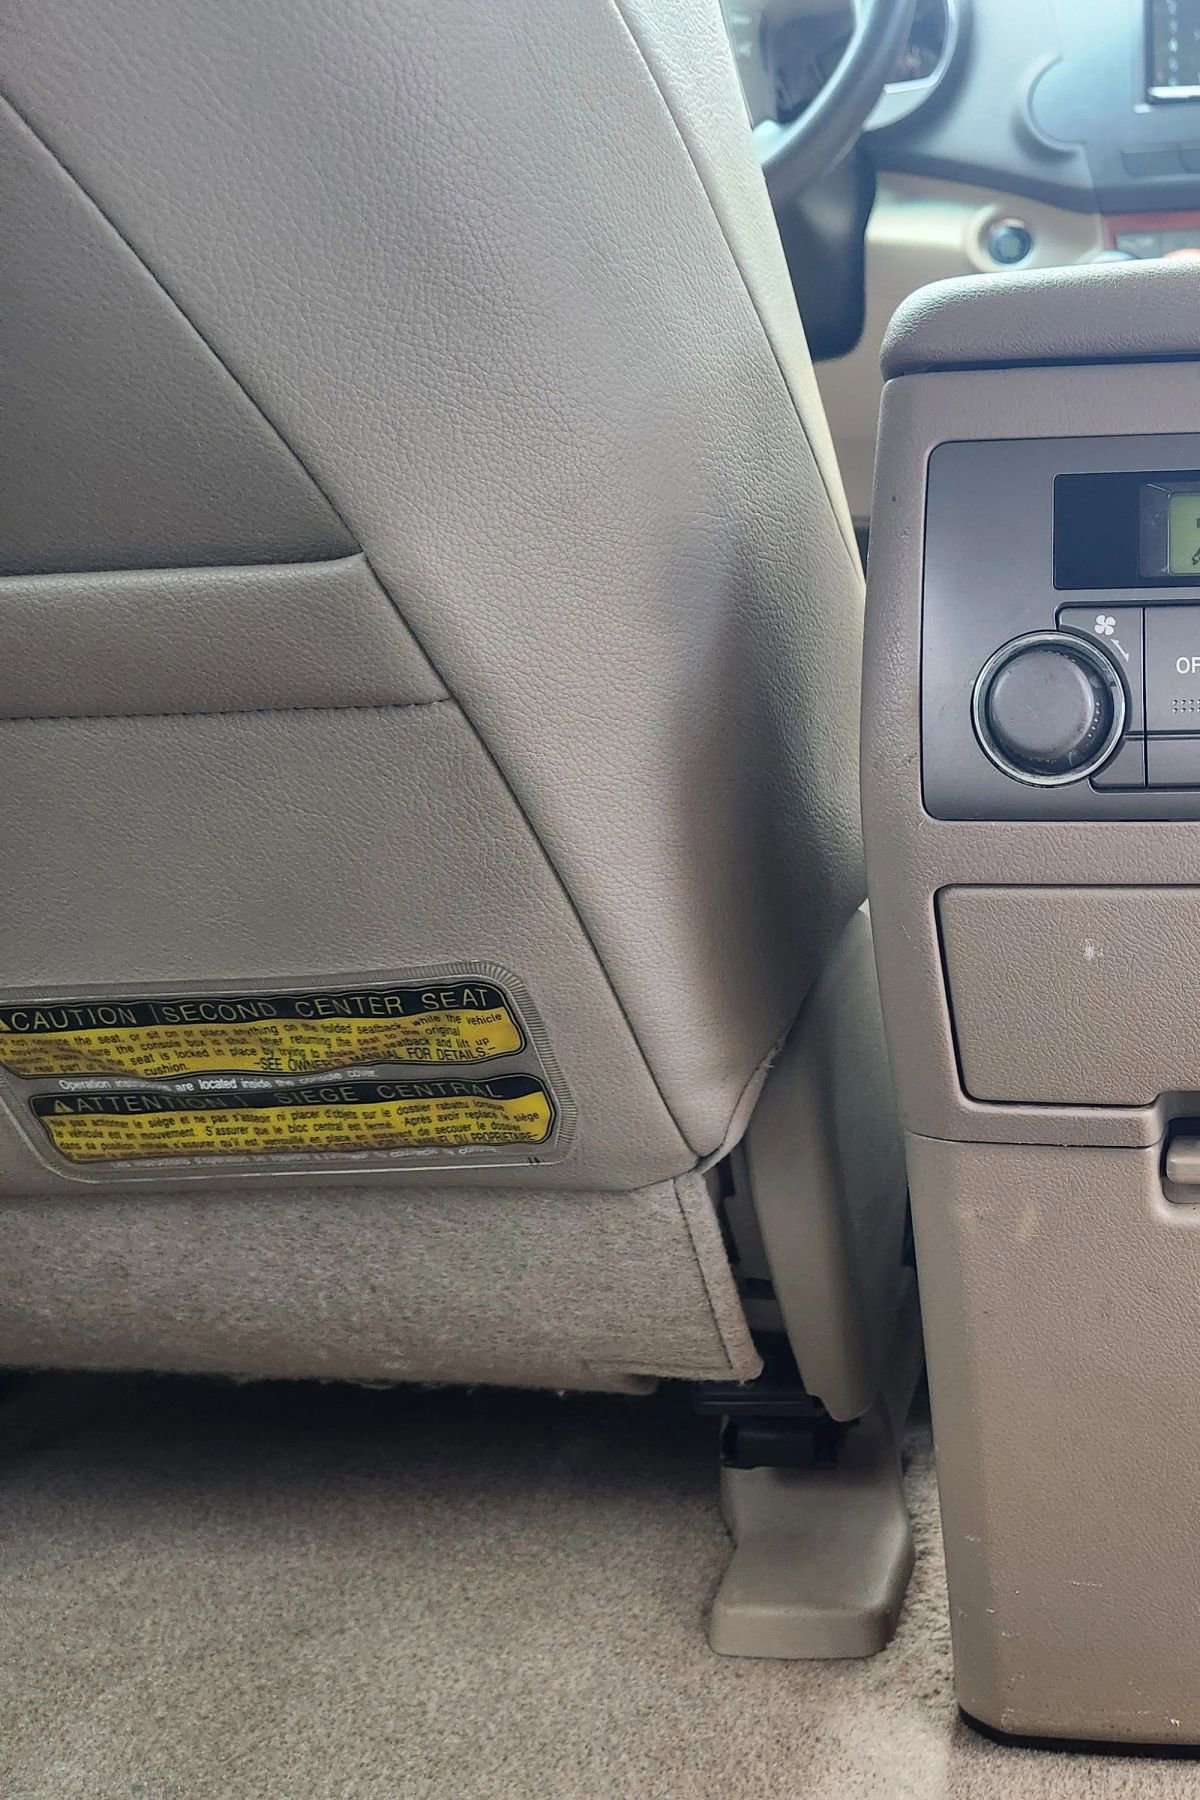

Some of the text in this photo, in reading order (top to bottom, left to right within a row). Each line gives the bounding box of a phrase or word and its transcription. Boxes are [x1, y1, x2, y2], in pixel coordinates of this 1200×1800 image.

[11, 988, 488, 1031] CAUTION SECOND CENTER SEAT
[74, 1035, 92, 1045] the
[129, 1033, 140, 1041] or
[284, 1023, 298, 1032] on
[411, 1014, 440, 1026] while
[446, 1013, 461, 1024] the
[466, 1012, 502, 1025] vehicle
[116, 1045, 135, 1054] the
[425, 1025, 461, 1038] original
[129, 1053, 155, 1066] seat
[160, 1051, 170, 1061] is
[229, 1046, 257, 1057] place
[475, 1036, 489, 1046] up
[407, 1047, 433, 1060] FOR
[58, 1079, 110, 1092] Operation
[175, 1082, 195, 1092] are
[198, 1079, 238, 1090] located
[77, 1082, 503, 1112] ATTENTION SIEGE CENTRAL
